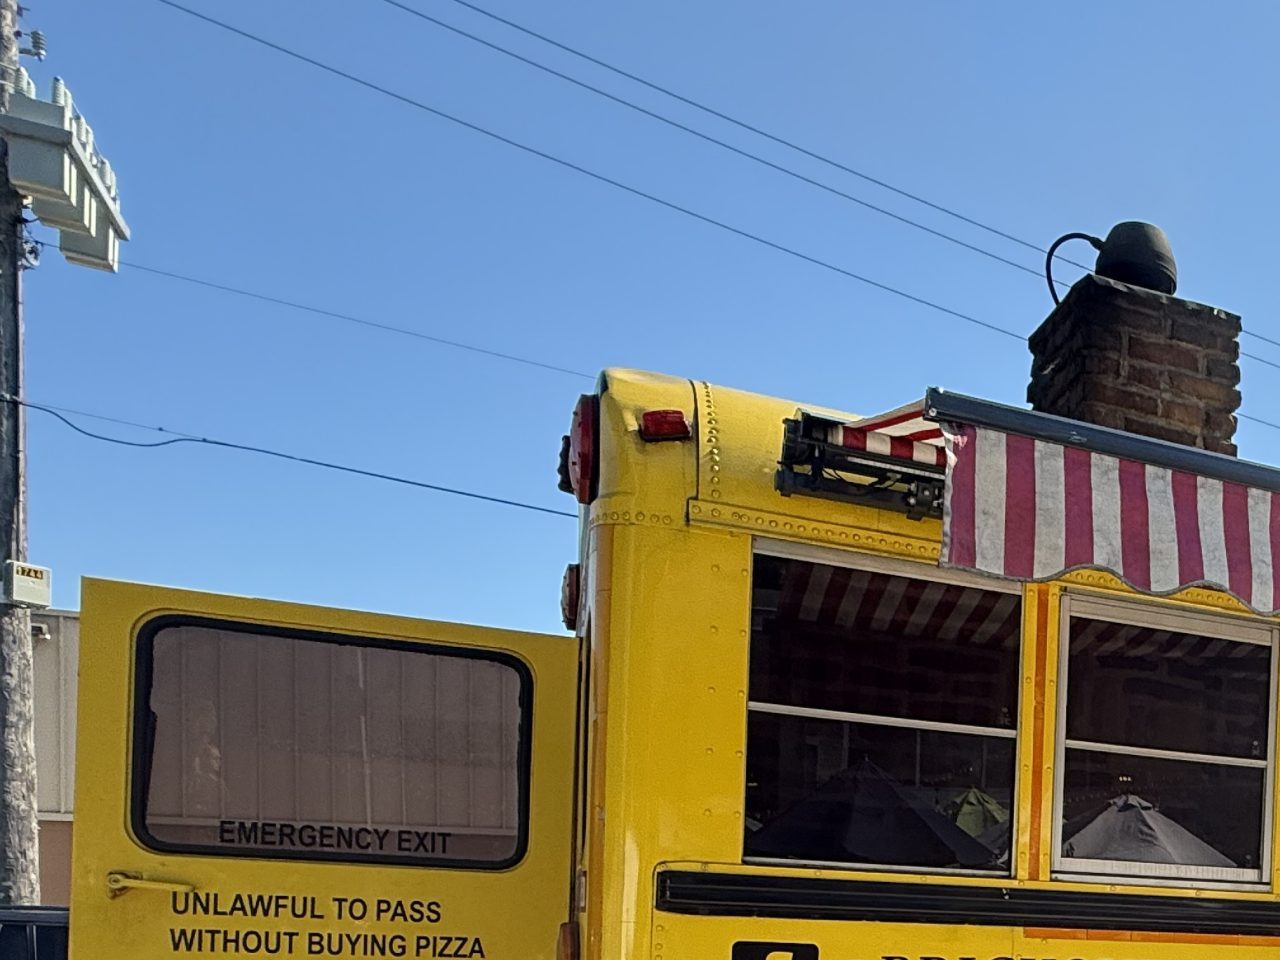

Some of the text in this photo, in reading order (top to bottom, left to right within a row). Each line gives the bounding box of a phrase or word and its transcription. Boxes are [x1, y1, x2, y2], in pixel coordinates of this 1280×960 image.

[218, 820, 451, 854] EMERGENCY EXIT
[171, 891, 442, 923] UNLAWFUL TO PASS
[170, 928, 486, 959] WITHOUT BUYING PIZZA
